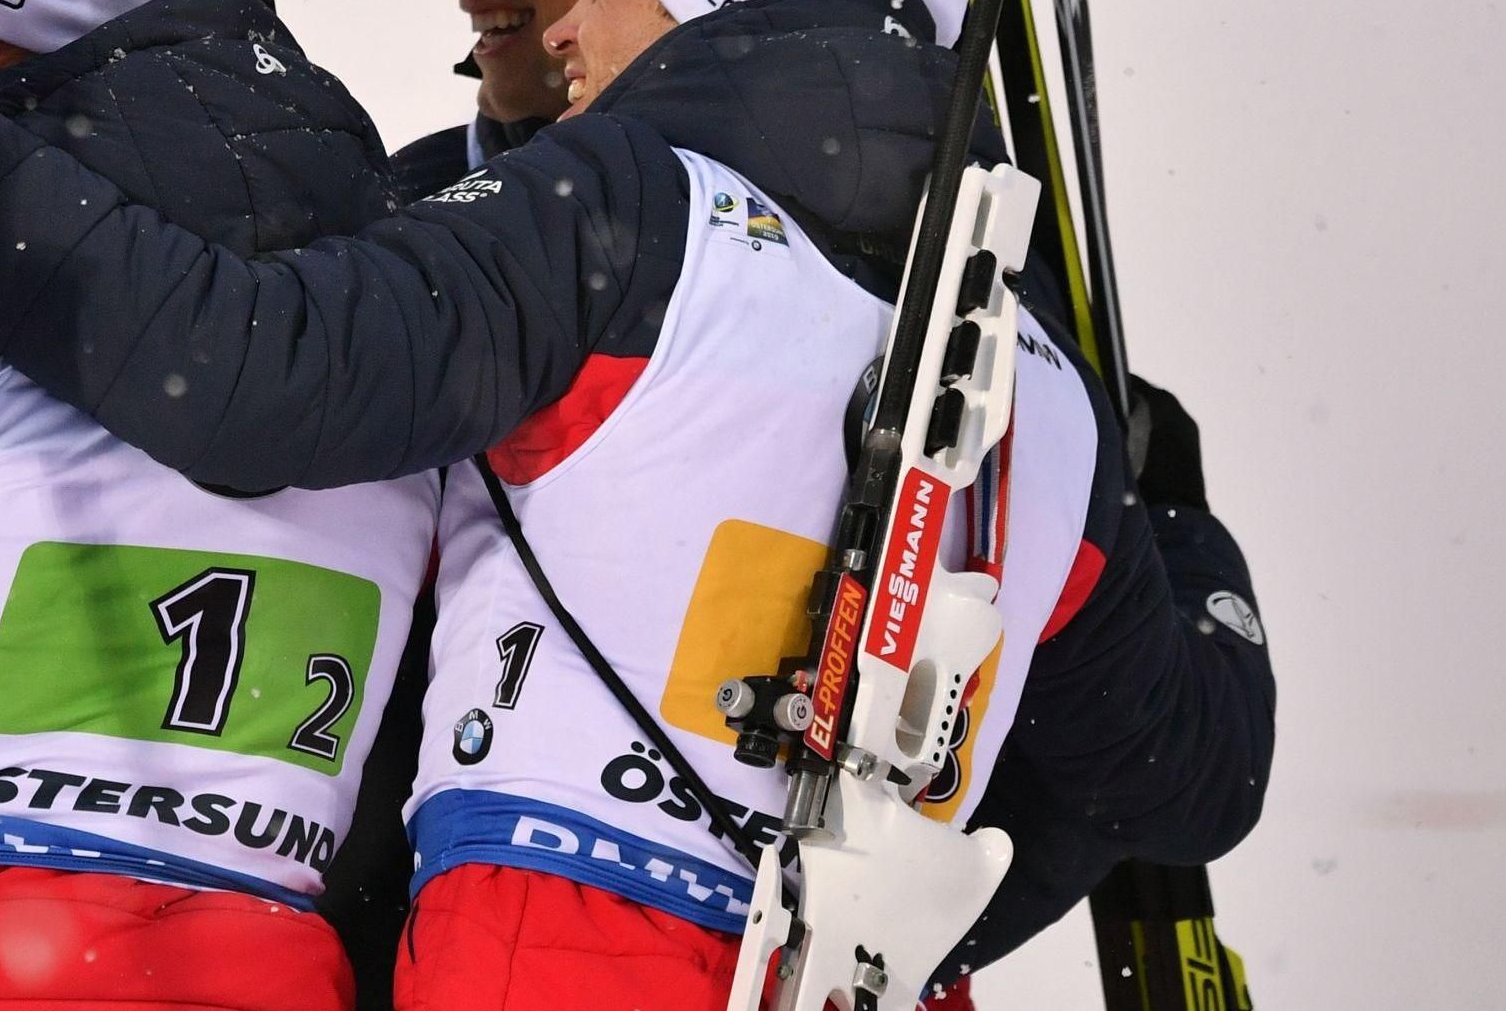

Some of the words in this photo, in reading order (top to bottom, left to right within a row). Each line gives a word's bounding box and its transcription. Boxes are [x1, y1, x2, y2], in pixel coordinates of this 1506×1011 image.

[880, 479, 934, 656] VIESSMANN
[148, 566, 257, 737] 1
[286, 653, 355, 763] 2
[492, 621, 546, 710] 1
